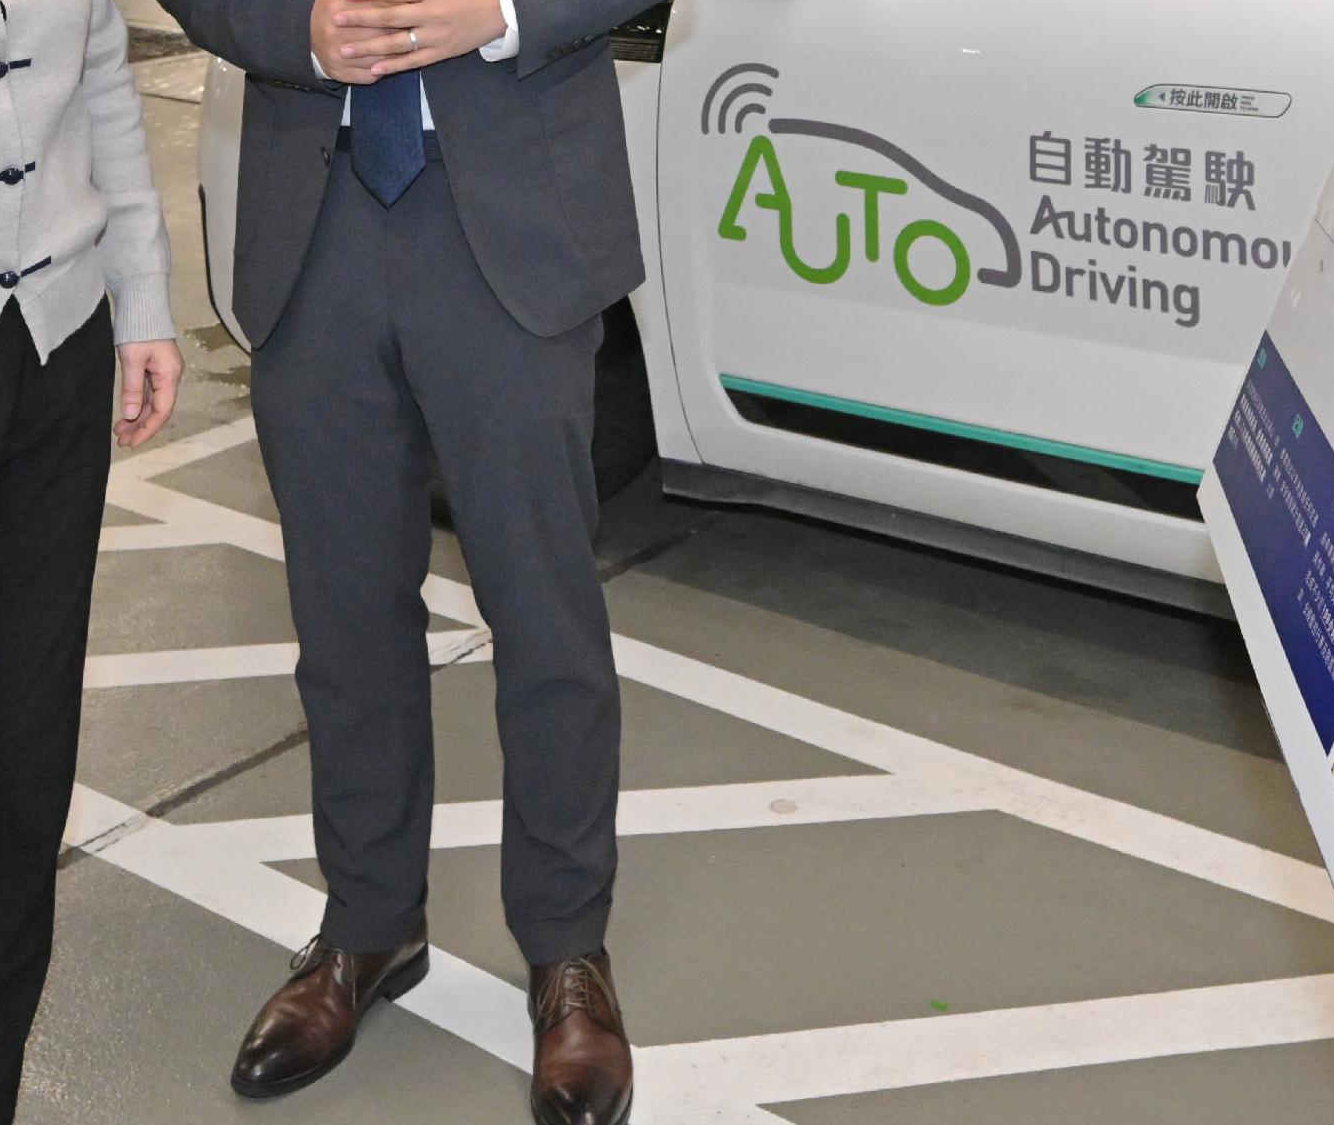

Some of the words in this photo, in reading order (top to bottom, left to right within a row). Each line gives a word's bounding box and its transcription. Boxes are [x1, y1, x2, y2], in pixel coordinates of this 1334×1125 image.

[1169, 88, 1239, 111] 按此開啟
[1029, 131, 1256, 211] 自動駕駛
[1030, 250, 1201, 328] Driving
